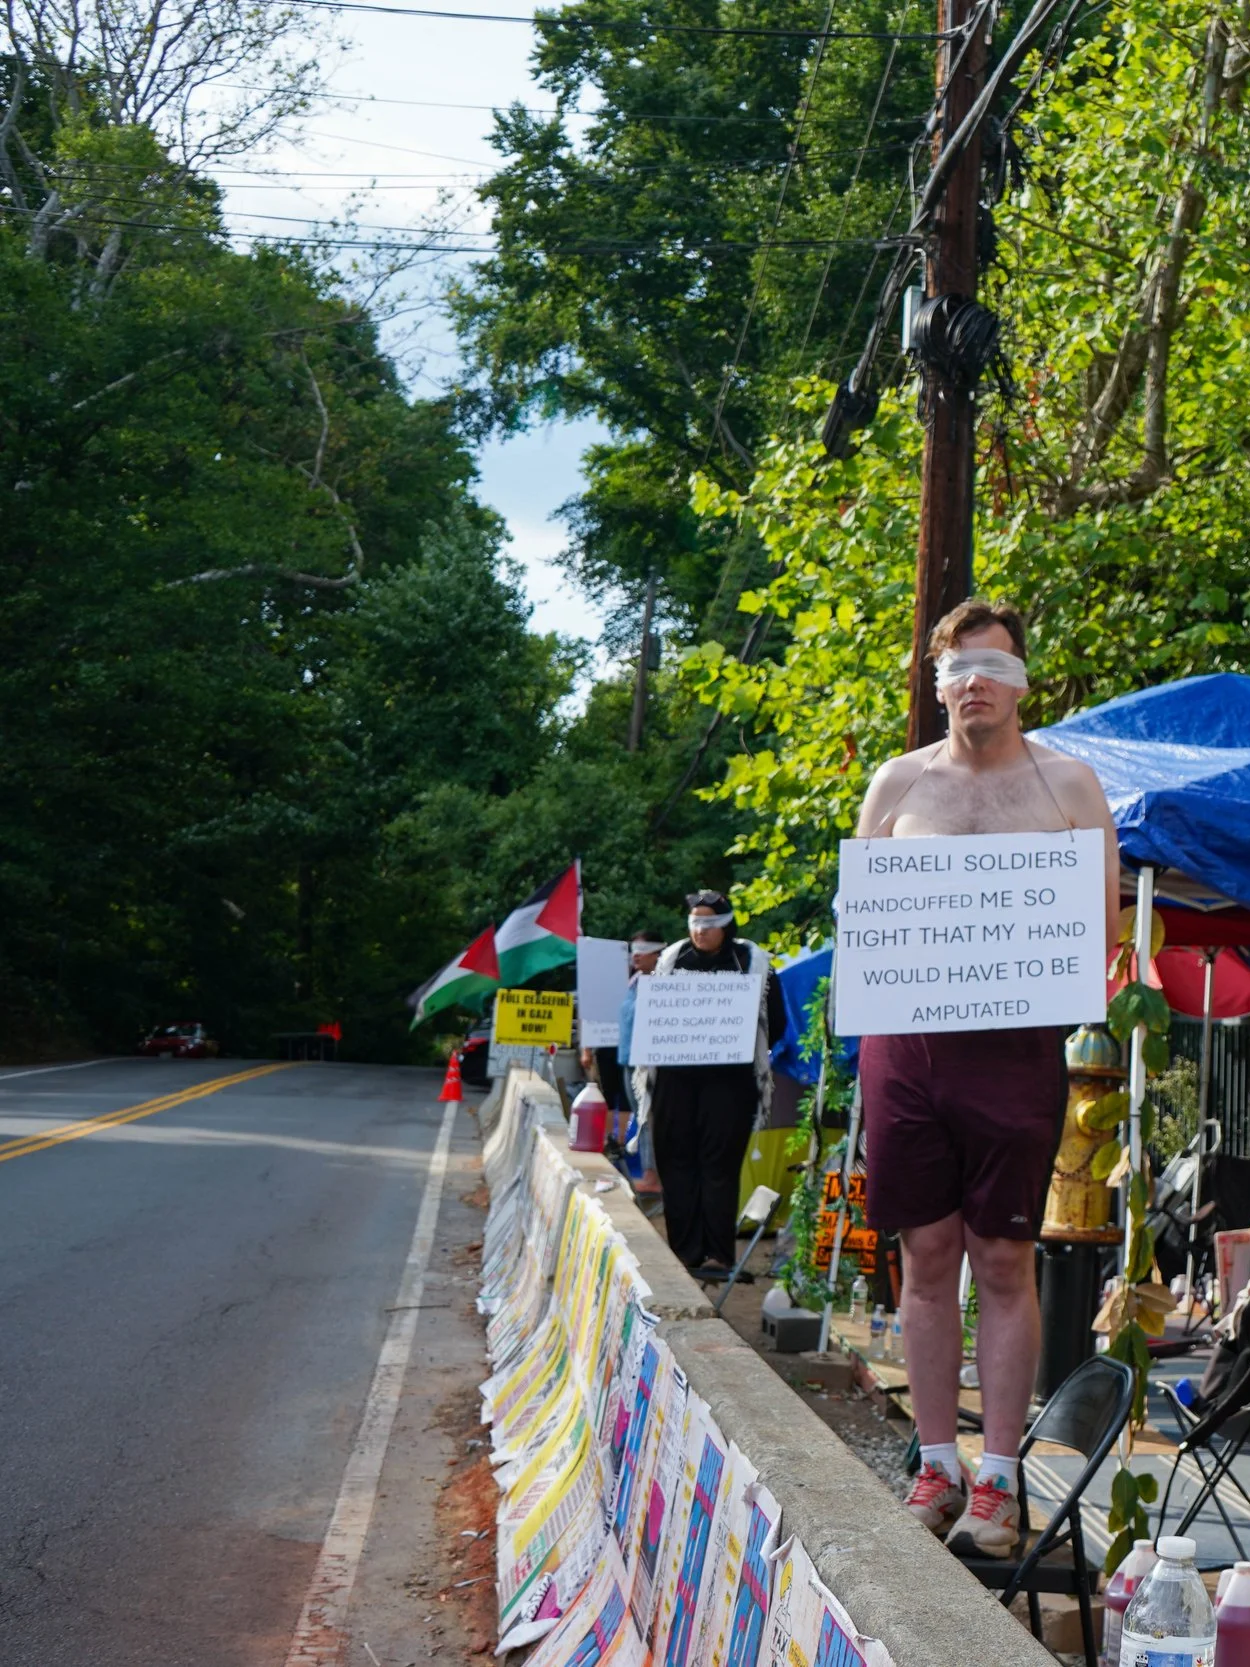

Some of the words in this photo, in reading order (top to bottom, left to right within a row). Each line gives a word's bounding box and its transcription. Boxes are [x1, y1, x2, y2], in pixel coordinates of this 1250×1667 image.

[868, 854, 952, 874] ISRAELI
[964, 850, 1078, 872] SOLDIERS
[845, 894, 973, 914] HANDCUFFED
[980, 890, 1013, 909] ME
[1023, 887, 1056, 907] SO
[843, 928, 912, 949] TIGHT
[919, 924, 976, 945] THAT
[982, 922, 1016, 943] MY
[1028, 921, 1086, 940] HAND
[863, 967, 941, 986] WOULD
[948, 962, 1009, 984] HAVE
[1014, 959, 1044, 978] TO
[1051, 956, 1080, 976] BE
[650, 983, 691, 992] ISRAELI
[697, 982, 750, 992] SOLDIERS
[501, 993, 520, 1005] FULL
[524, 995, 570, 1008] CEASEFIRE
[648, 998, 690, 1009] PULLED
[693, 997, 714, 1007] OFF
[717, 997, 734, 1006] MY
[517, 1008, 527, 1019] IN
[530, 1009, 553, 1020] GAZA
[911, 999, 1031, 1023] AMPUTATED
[648, 1017, 679, 1028] HEAD
[682, 1017, 717, 1027] SCARF
[720, 1015, 744, 1026] AND
[521, 1023, 547, 1034] NOW!
[652, 1034, 689, 1045] BARED
[691, 1034, 707, 1044] MY
[709, 1034, 741, 1045] BODY
[648, 1052, 661, 1063] TO
[664, 1052, 721, 1063] HUMILIATE
[727, 1052, 744, 1061] ME
